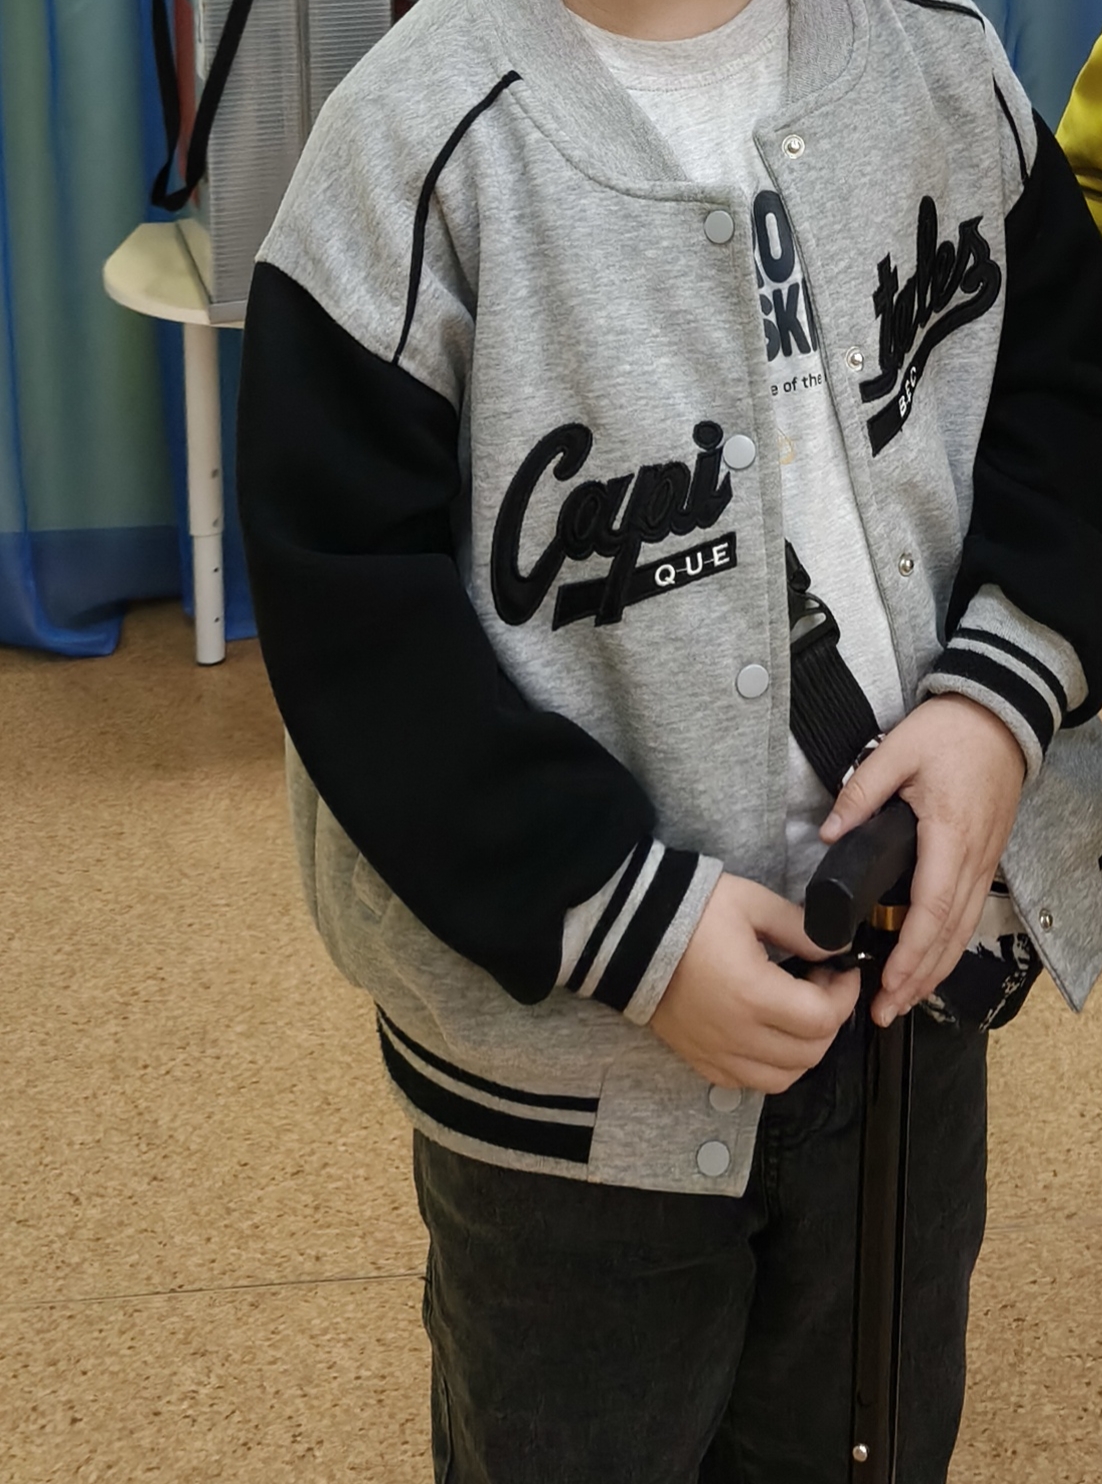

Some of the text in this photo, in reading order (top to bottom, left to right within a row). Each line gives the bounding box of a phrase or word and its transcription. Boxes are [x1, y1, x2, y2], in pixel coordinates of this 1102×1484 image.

[783, 377, 797, 392] of
[802, 373, 822, 388] the
[491, 421, 733, 626] Capi
[655, 543, 730, 587] QUE
